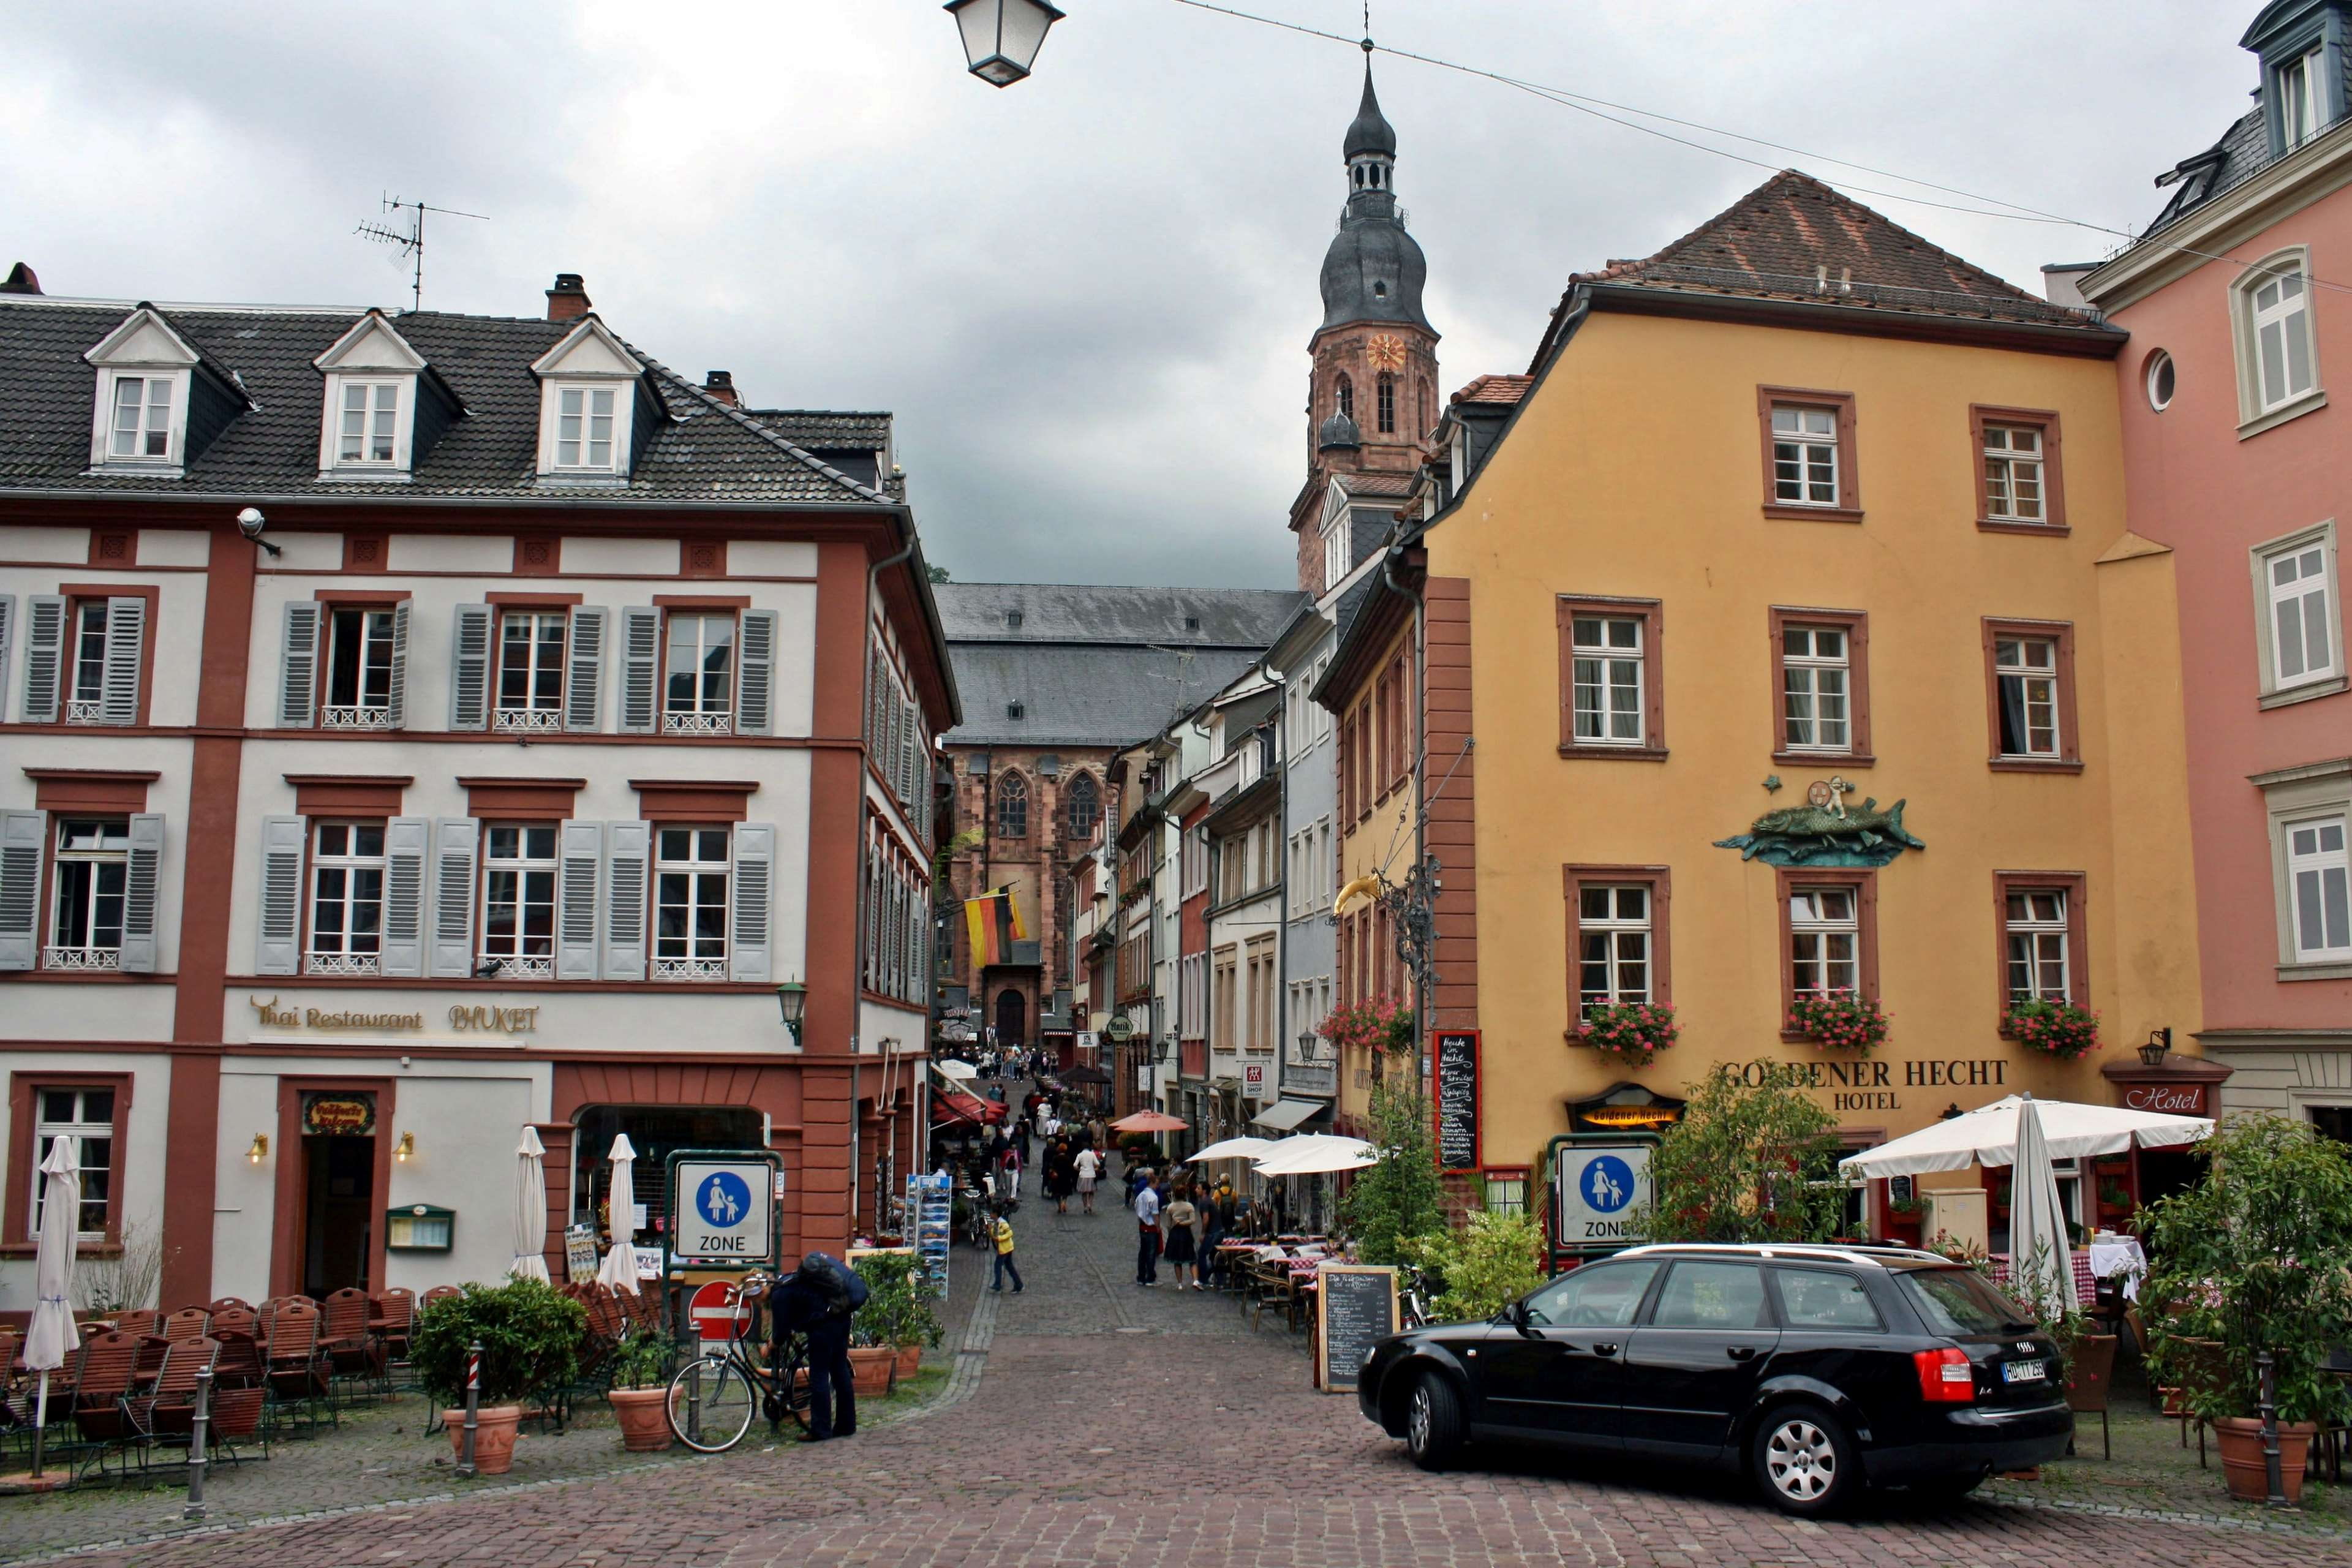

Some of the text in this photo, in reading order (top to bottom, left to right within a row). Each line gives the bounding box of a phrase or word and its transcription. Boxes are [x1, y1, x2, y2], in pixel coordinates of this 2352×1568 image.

[250, 995, 540, 1033] Thai Restaurant PHUKET
[1444, 1037, 1465, 1047] Heute
[1441, 1053, 1464, 1062] Hecht
[1722, 1060, 2008, 1088] GODENER HECHT
[1834, 1092, 1901, 1110] HOTEL
[2127, 1088, 2199, 1109] Hotel
[1594, 1110, 1667, 1120] Goldener Hecht
[699, 1236, 745, 1251] ZONE
[2006, 1360, 2044, 1379] HD TT 255
[1979, 1386, 1992, 1395] A4
